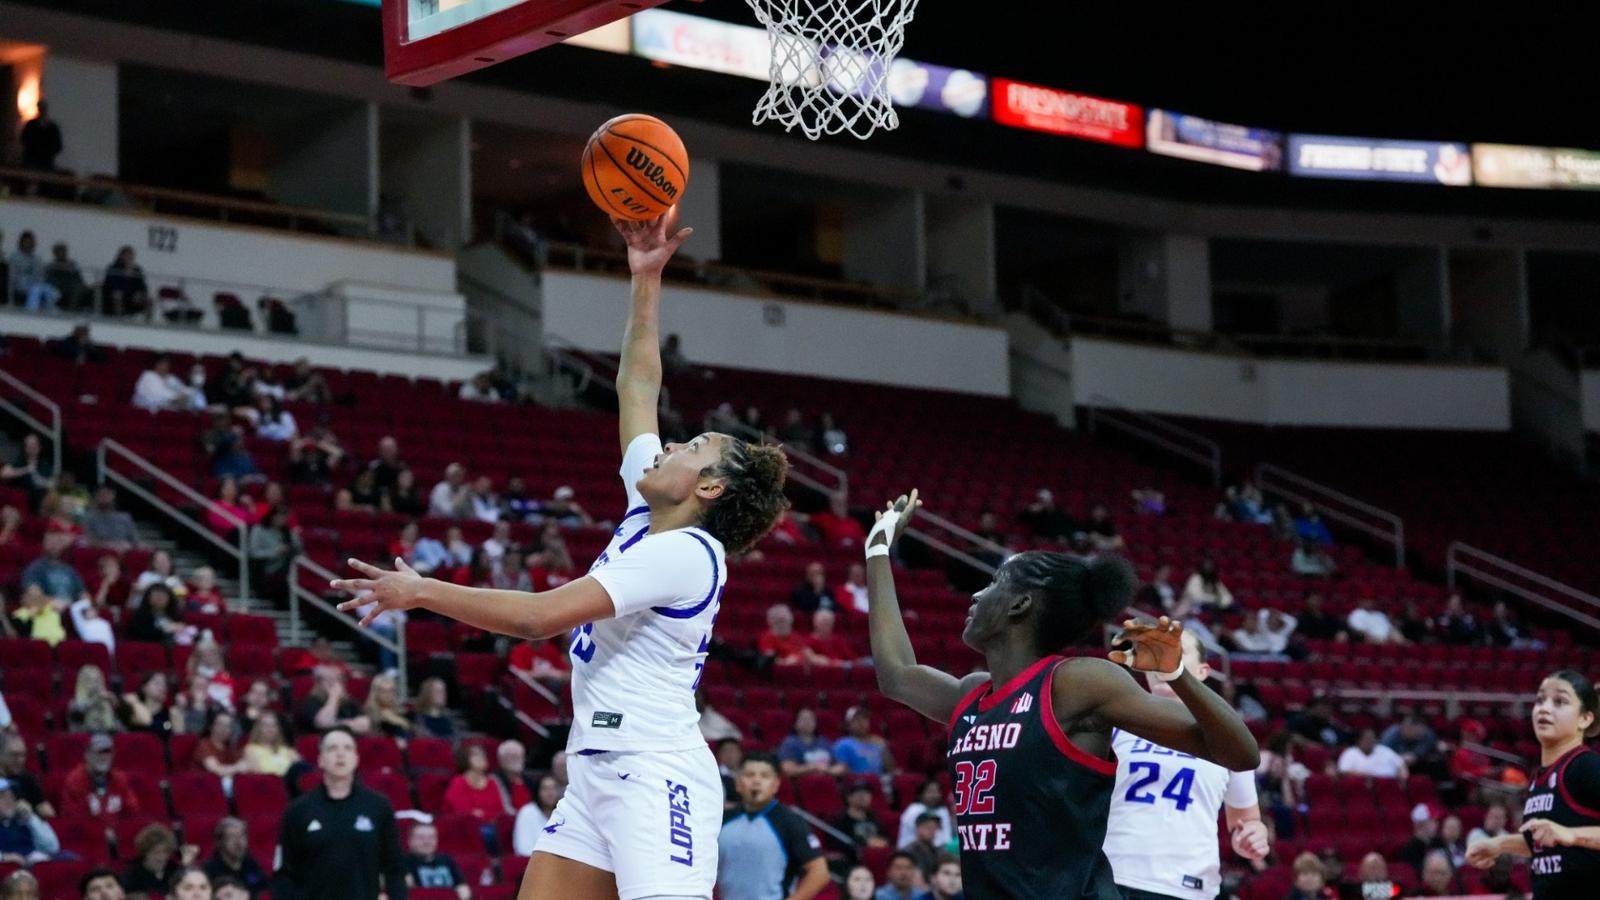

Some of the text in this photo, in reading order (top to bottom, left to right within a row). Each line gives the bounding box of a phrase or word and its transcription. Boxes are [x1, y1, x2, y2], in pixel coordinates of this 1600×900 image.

[626, 146, 678, 200] Wilson
[955, 759, 997, 816] 32
[1125, 761, 1196, 812] 24
[665, 779, 693, 867] LOPES
